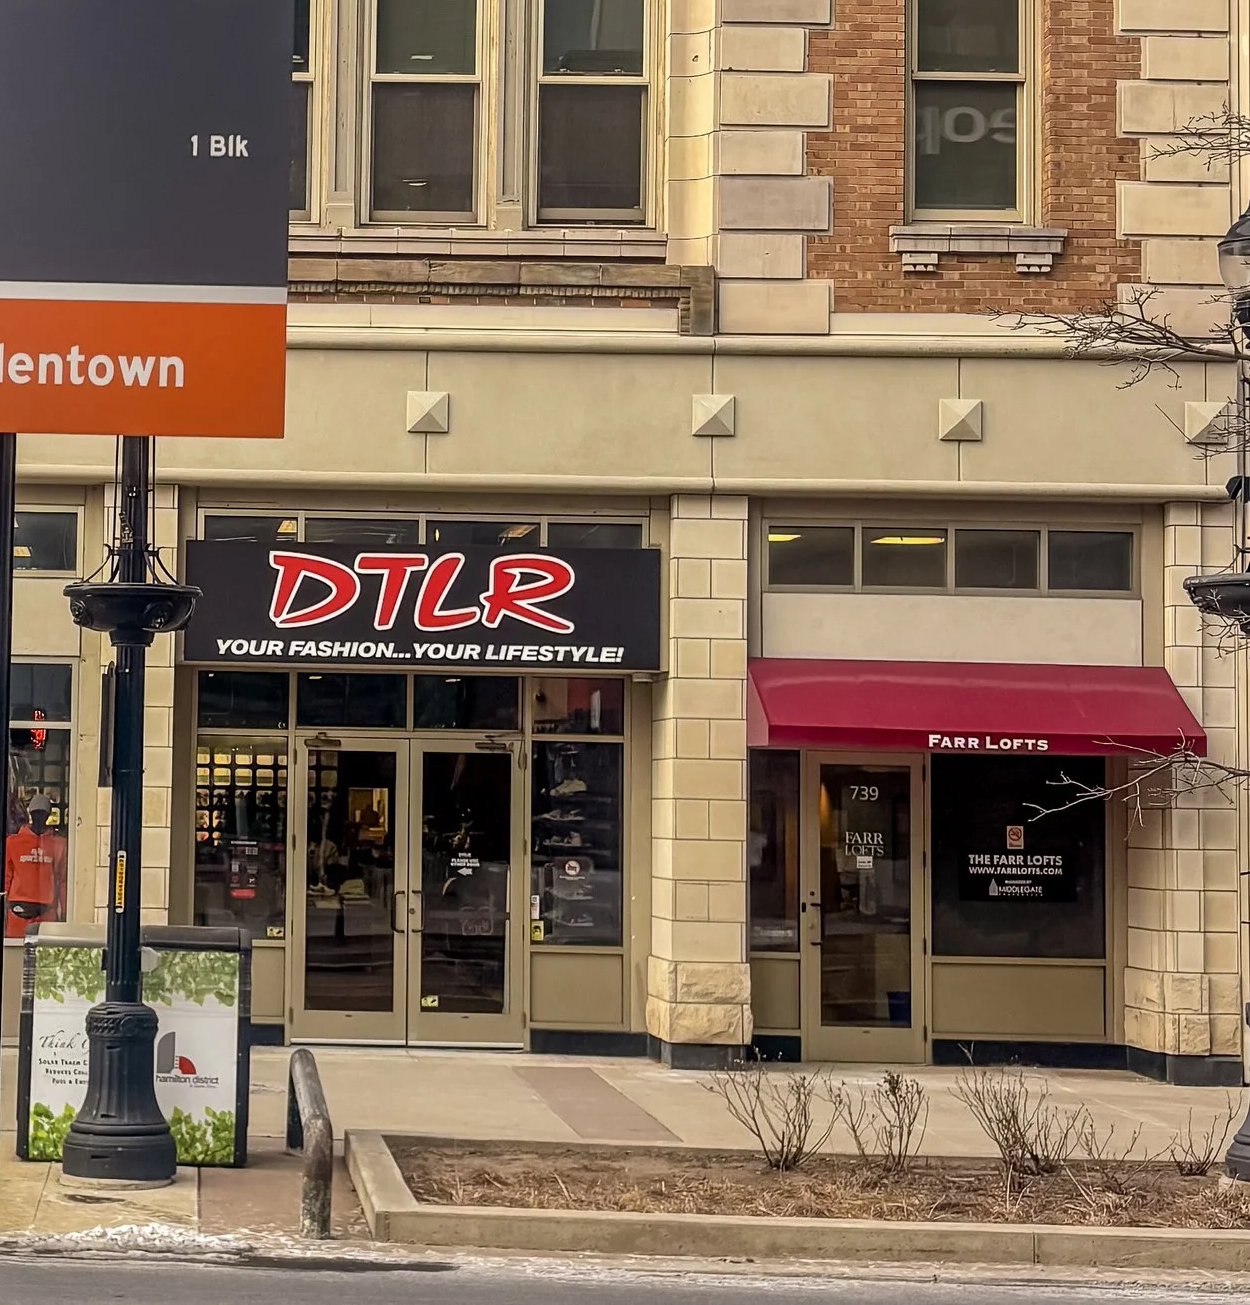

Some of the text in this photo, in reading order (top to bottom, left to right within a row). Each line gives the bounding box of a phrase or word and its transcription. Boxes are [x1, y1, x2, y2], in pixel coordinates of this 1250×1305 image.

[190, 134, 249, 157] 1 Blk
[269, 551, 575, 634] DTLR
[216, 639, 283, 657] YOUR
[485, 644, 625, 663] LIFESTYLE!
[929, 734, 1049, 751] FARR LOFTS
[850, 786, 879, 801] 739
[845, 831, 884, 845] FARR
[845, 845, 884, 857] LOFTS
[968, 854, 1063, 866] THE FARR LOFTS
[968, 866, 1063, 875] WWW.FARRLOFTS.COM
[39, 1029, 81, 1048] Think
[156, 1074, 219, 1084] hamilton district
